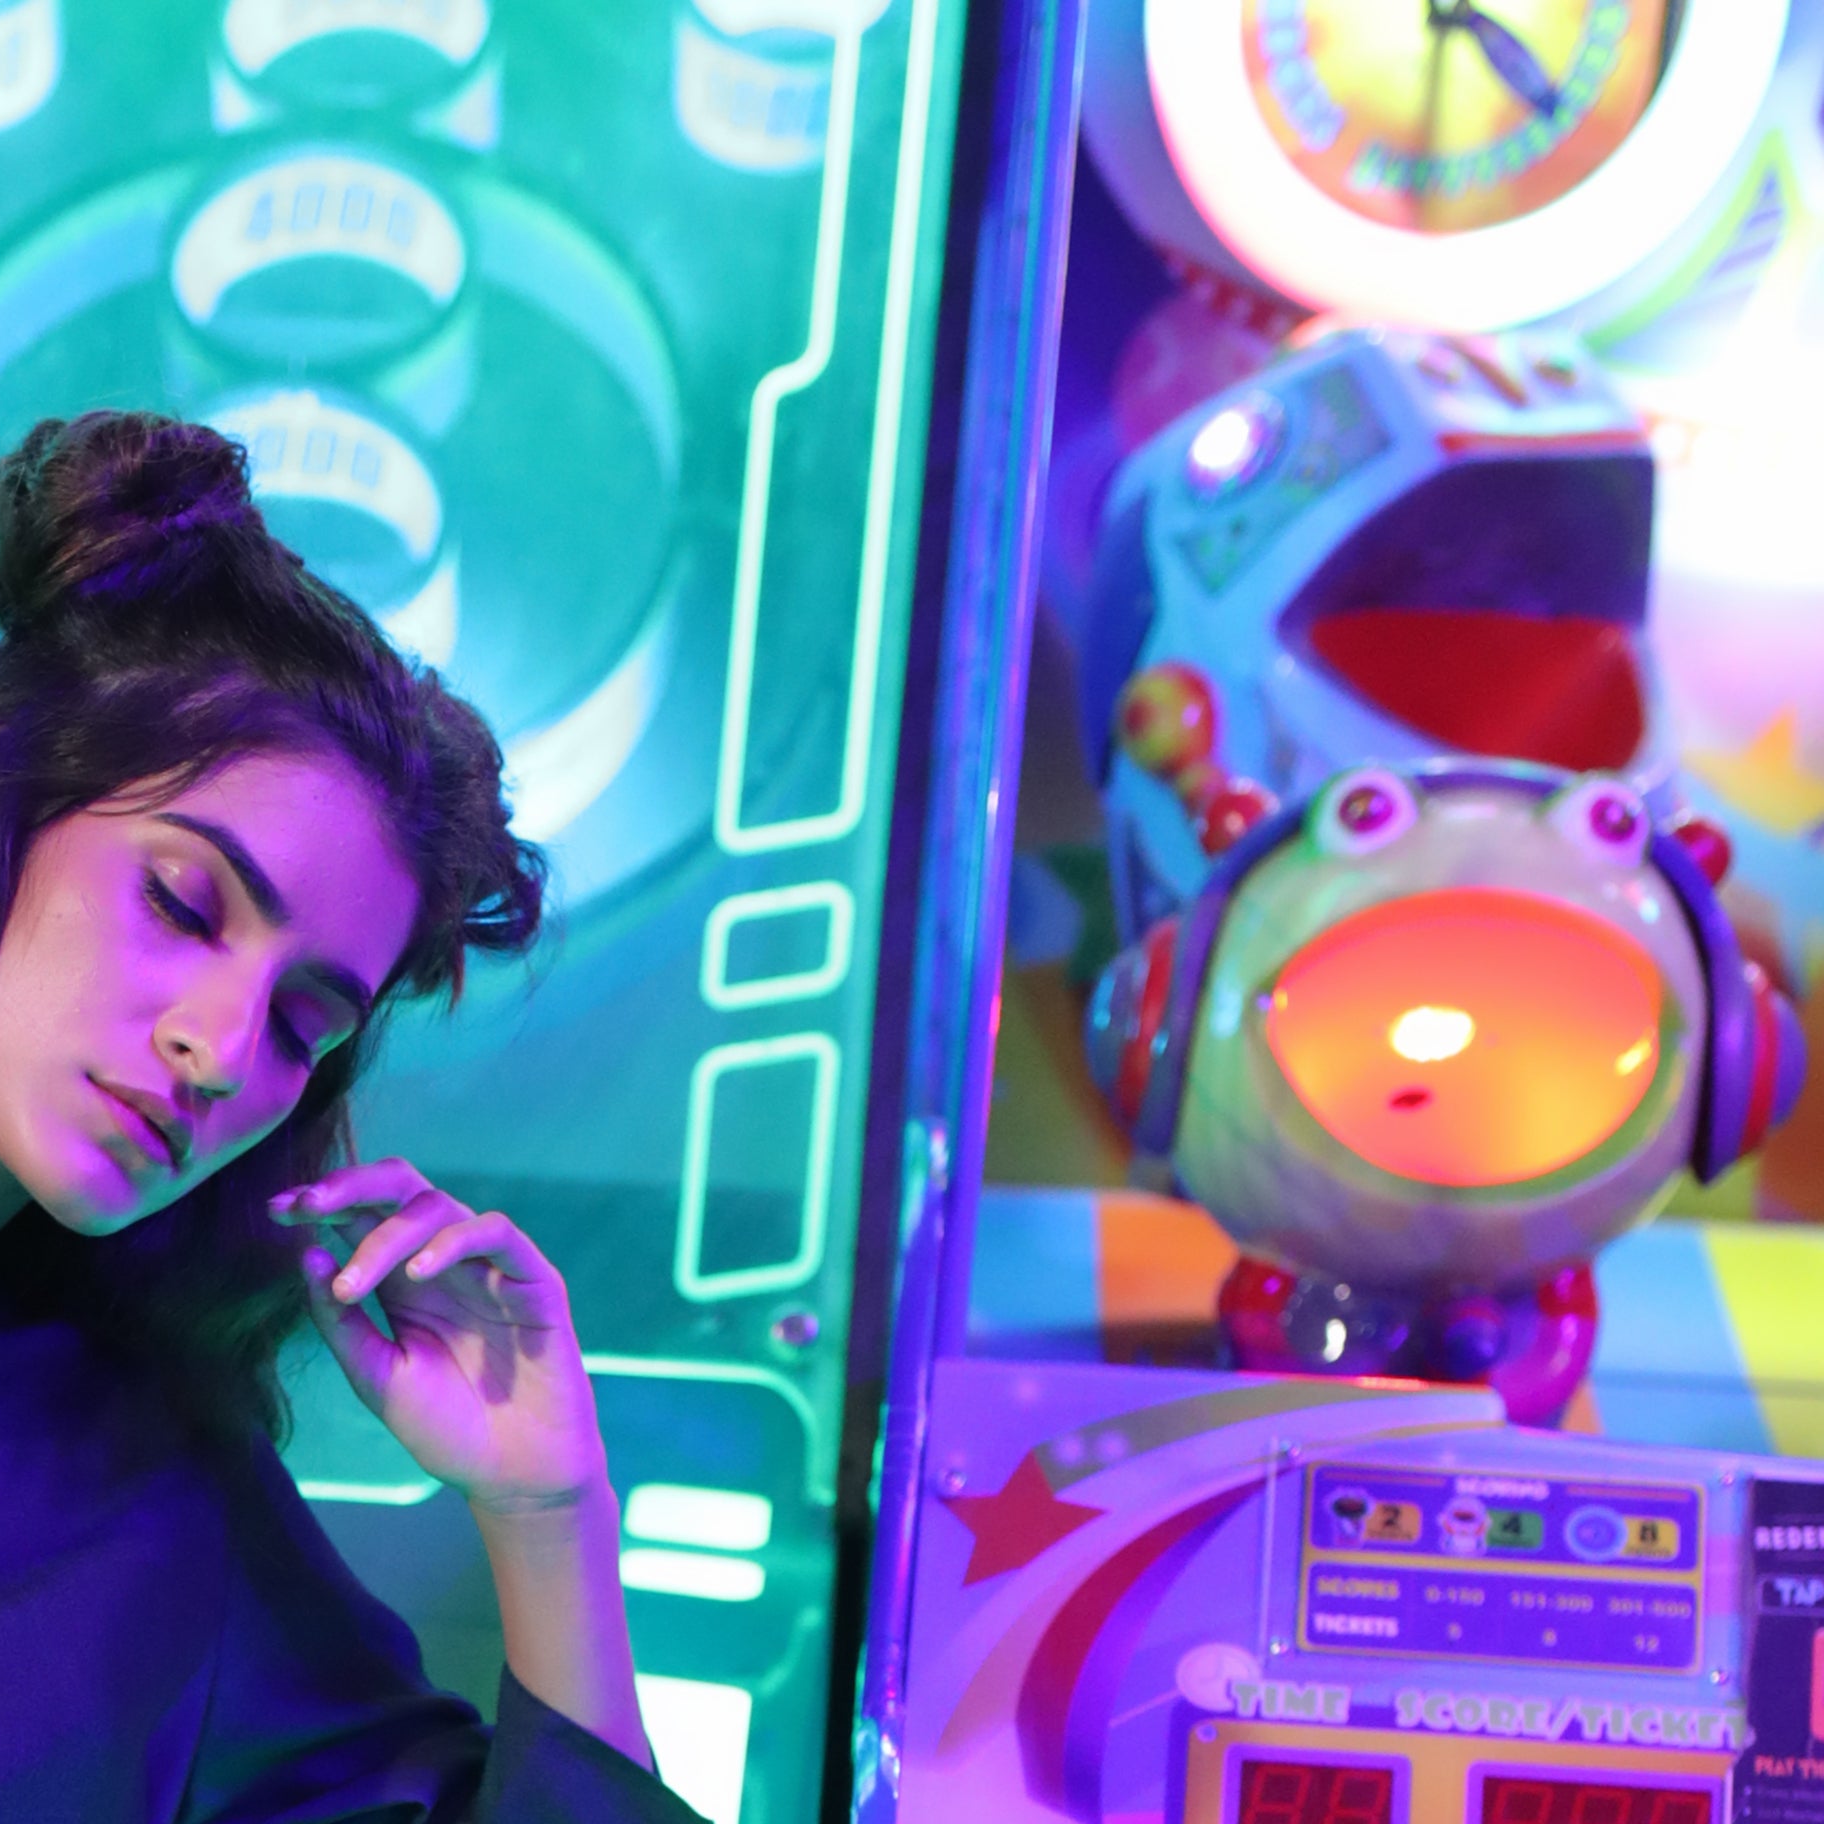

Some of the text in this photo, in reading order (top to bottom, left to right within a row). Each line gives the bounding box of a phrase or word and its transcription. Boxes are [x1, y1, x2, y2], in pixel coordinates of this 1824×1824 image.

[252, 427, 382, 488] 000
[1381, 1505, 1402, 1530] 2
[1231, 1682, 1351, 1724] TIME
